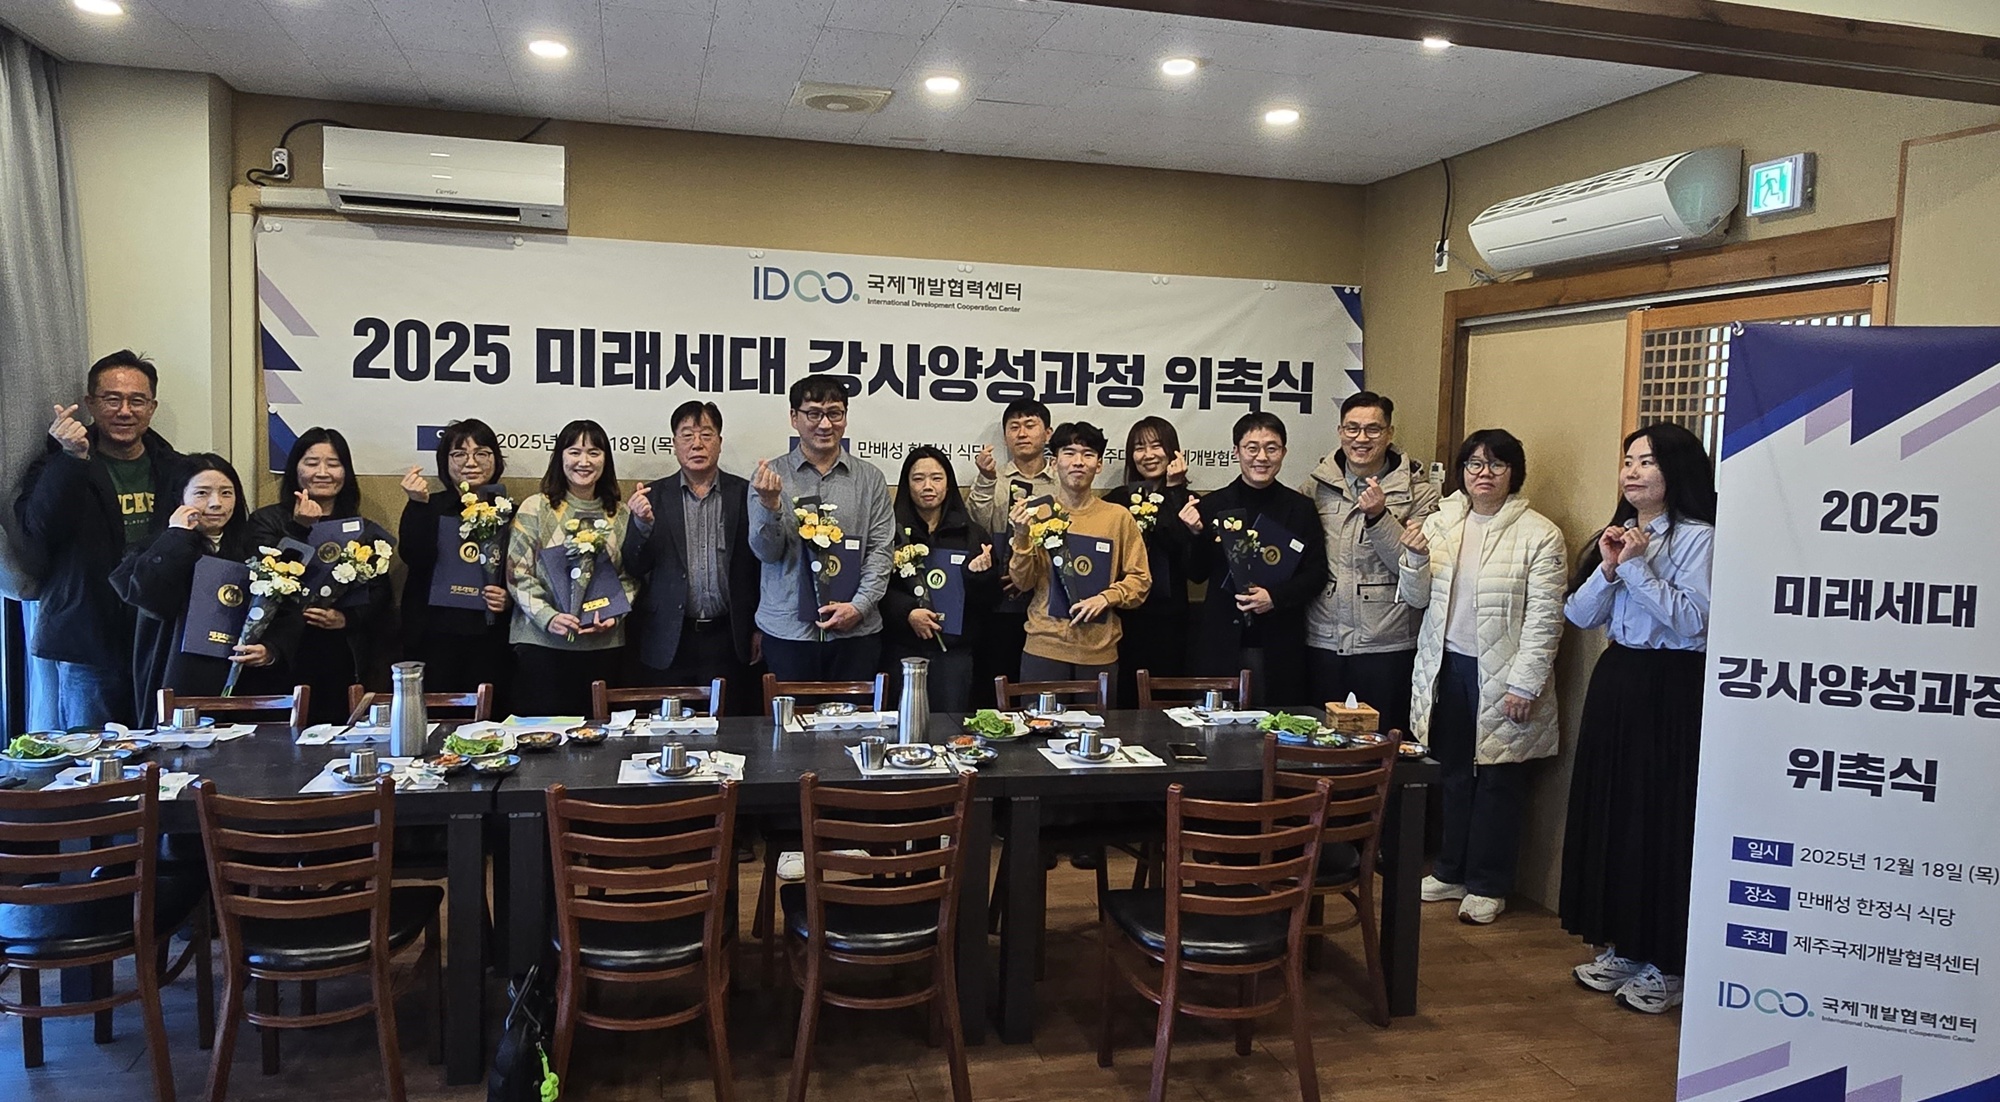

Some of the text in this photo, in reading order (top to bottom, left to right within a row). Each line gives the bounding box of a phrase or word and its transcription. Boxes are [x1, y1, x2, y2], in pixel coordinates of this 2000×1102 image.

[867, 274, 1022, 301] 국제개발협력센터
[867, 298, 1021, 313] International Development Cooperation Center
[352, 317, 1314, 414] 2025 미래세대 강사양성과정 위촉식
[609, 436, 646, 454] 18일
[652, 436, 673, 455] (목
[857, 441, 903, 459] 만배성
[1820, 490, 1940, 536] 2025
[1773, 575, 1978, 628] 미래세대
[1786, 748, 1938, 802] 위촉식
[1748, 842, 2000, 886] 일시 2025년 12월 18일 (목)
[1744, 886, 1956, 927] 장소 만배성 한정식 식당
[1741, 929, 1980, 976] 주최 제주국제개발협력센터
[1821, 1015, 1862, 1028] International
[1864, 1021, 1908, 1034] Development
[1822, 997, 1977, 1034] 국제개발협력센터
